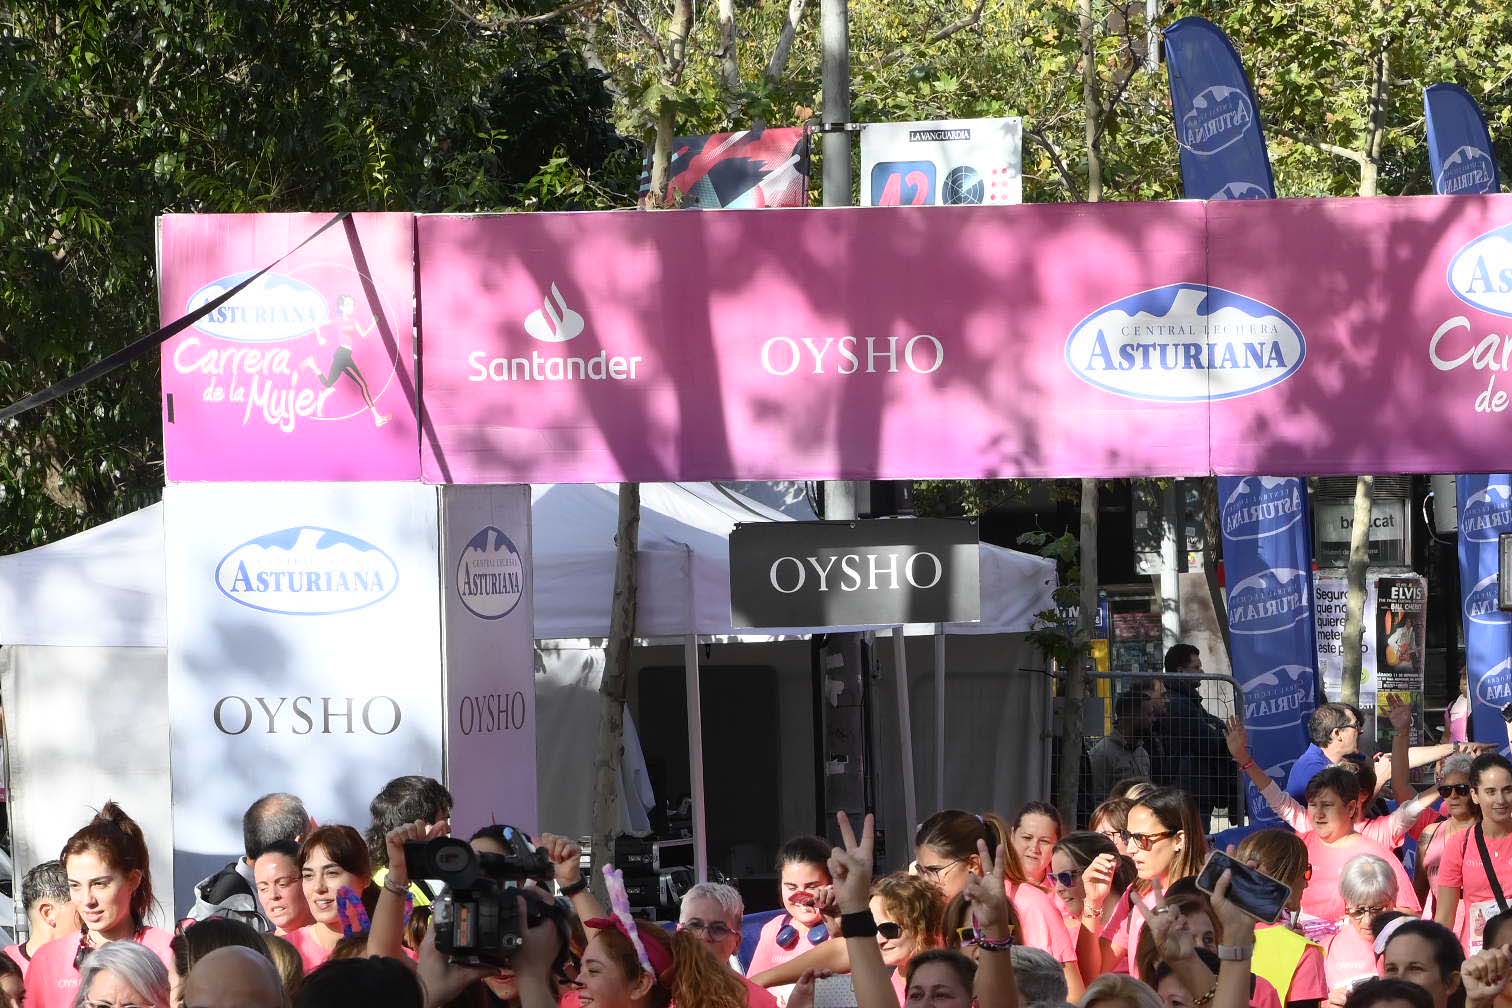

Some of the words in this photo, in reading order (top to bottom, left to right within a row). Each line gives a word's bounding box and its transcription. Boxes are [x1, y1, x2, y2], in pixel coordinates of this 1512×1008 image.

[1121, 324, 1195, 336] CENTRAL
[1203, 323, 1279, 335] LECHERA
[174, 337, 293, 376] Carrera
[468, 350, 643, 382] Santander
[761, 334, 944, 376] OYSHO
[1084, 328, 1287, 373] ASTURIANA
[203, 375, 225, 402] de
[229, 375, 245, 402] la
[243, 370, 336, 433] Mujer
[1474, 375, 1509, 414] de
[230, 560, 385, 593] ASTURIANA
[461, 561, 520, 597] ASTURIANA
[770, 552, 943, 594] OYSHO
[1316, 605, 1333, 616] que
[1391, 587, 1422, 600] ELVIS
[213, 695, 402, 736] OYSHO
[460, 691, 525, 736] OYSHO
